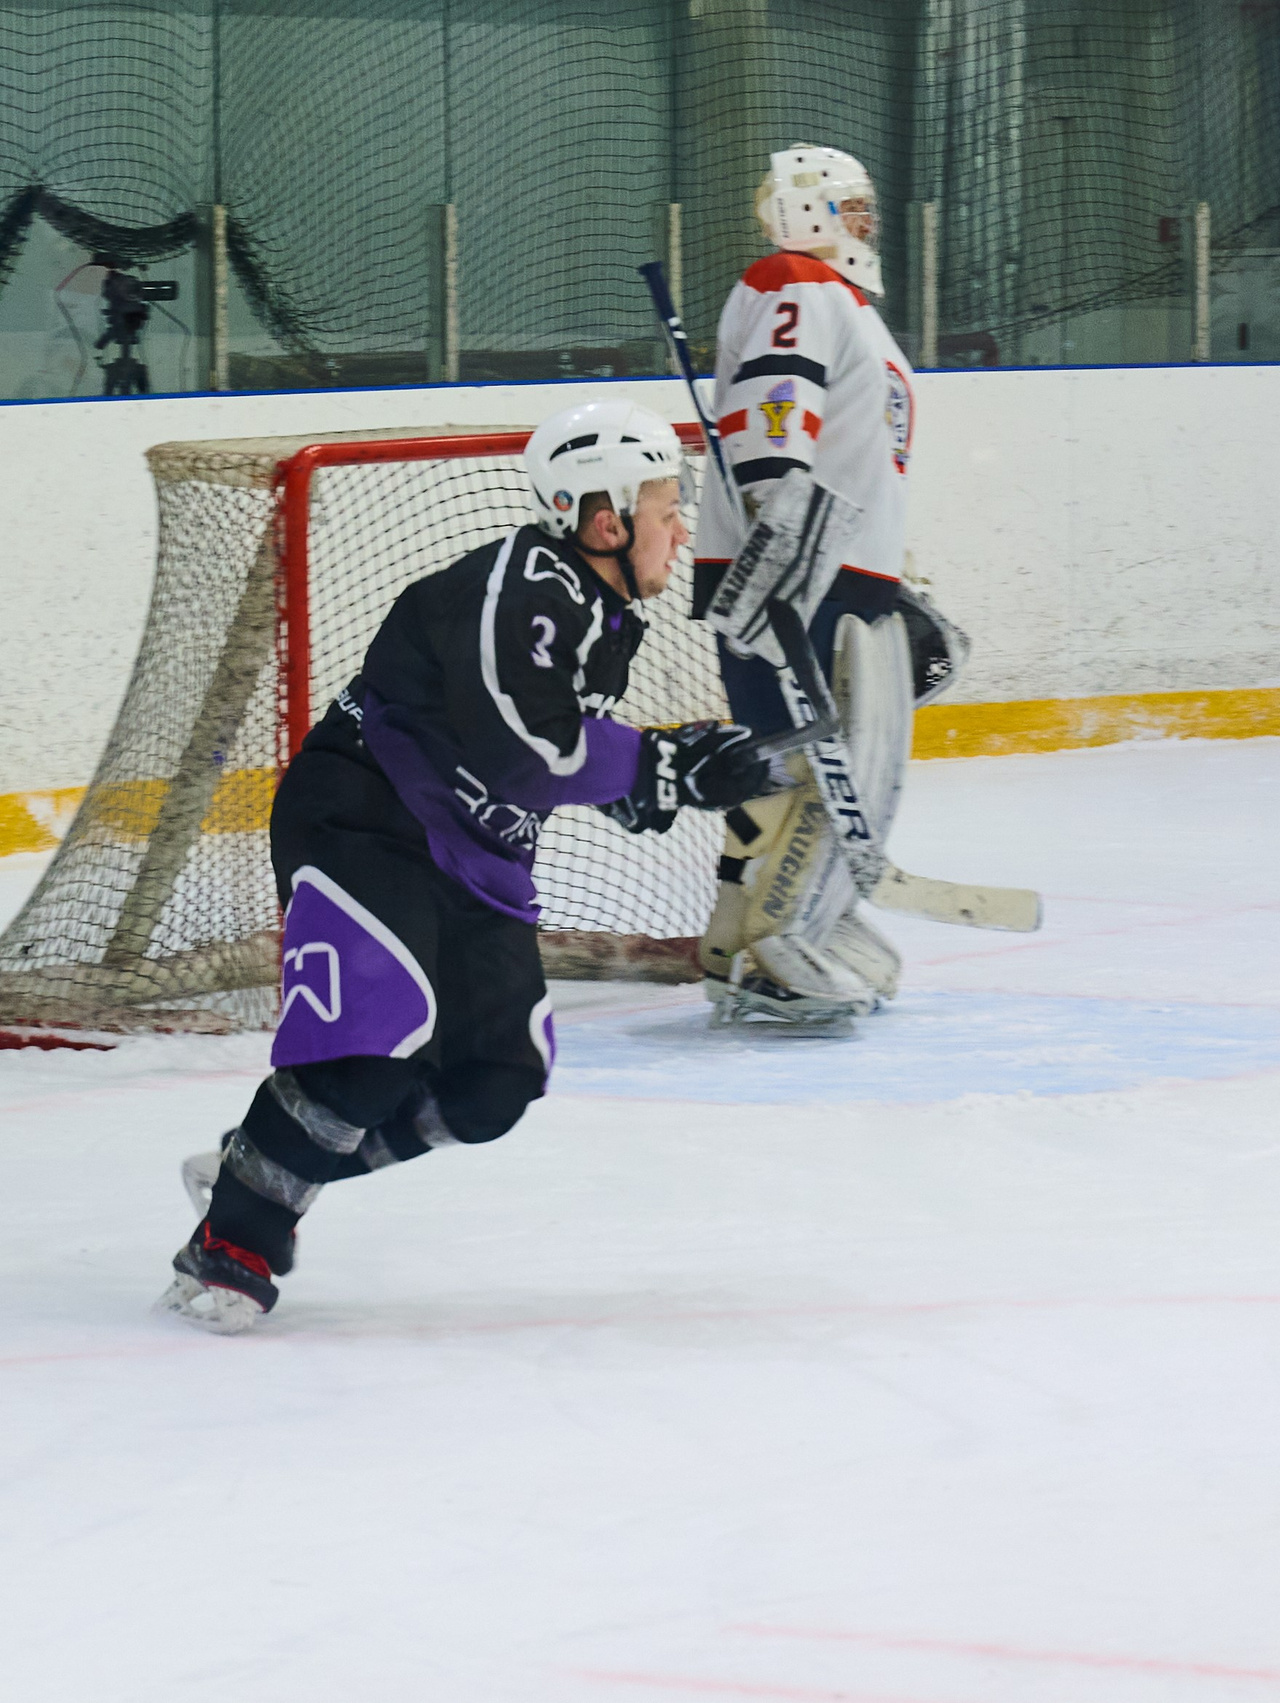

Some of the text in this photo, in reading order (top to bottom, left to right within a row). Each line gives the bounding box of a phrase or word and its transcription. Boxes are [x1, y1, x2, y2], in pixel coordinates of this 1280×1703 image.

[771, 302, 798, 348] 2
[760, 400, 795, 438] Y
[761, 801, 828, 920] VAUGHN
